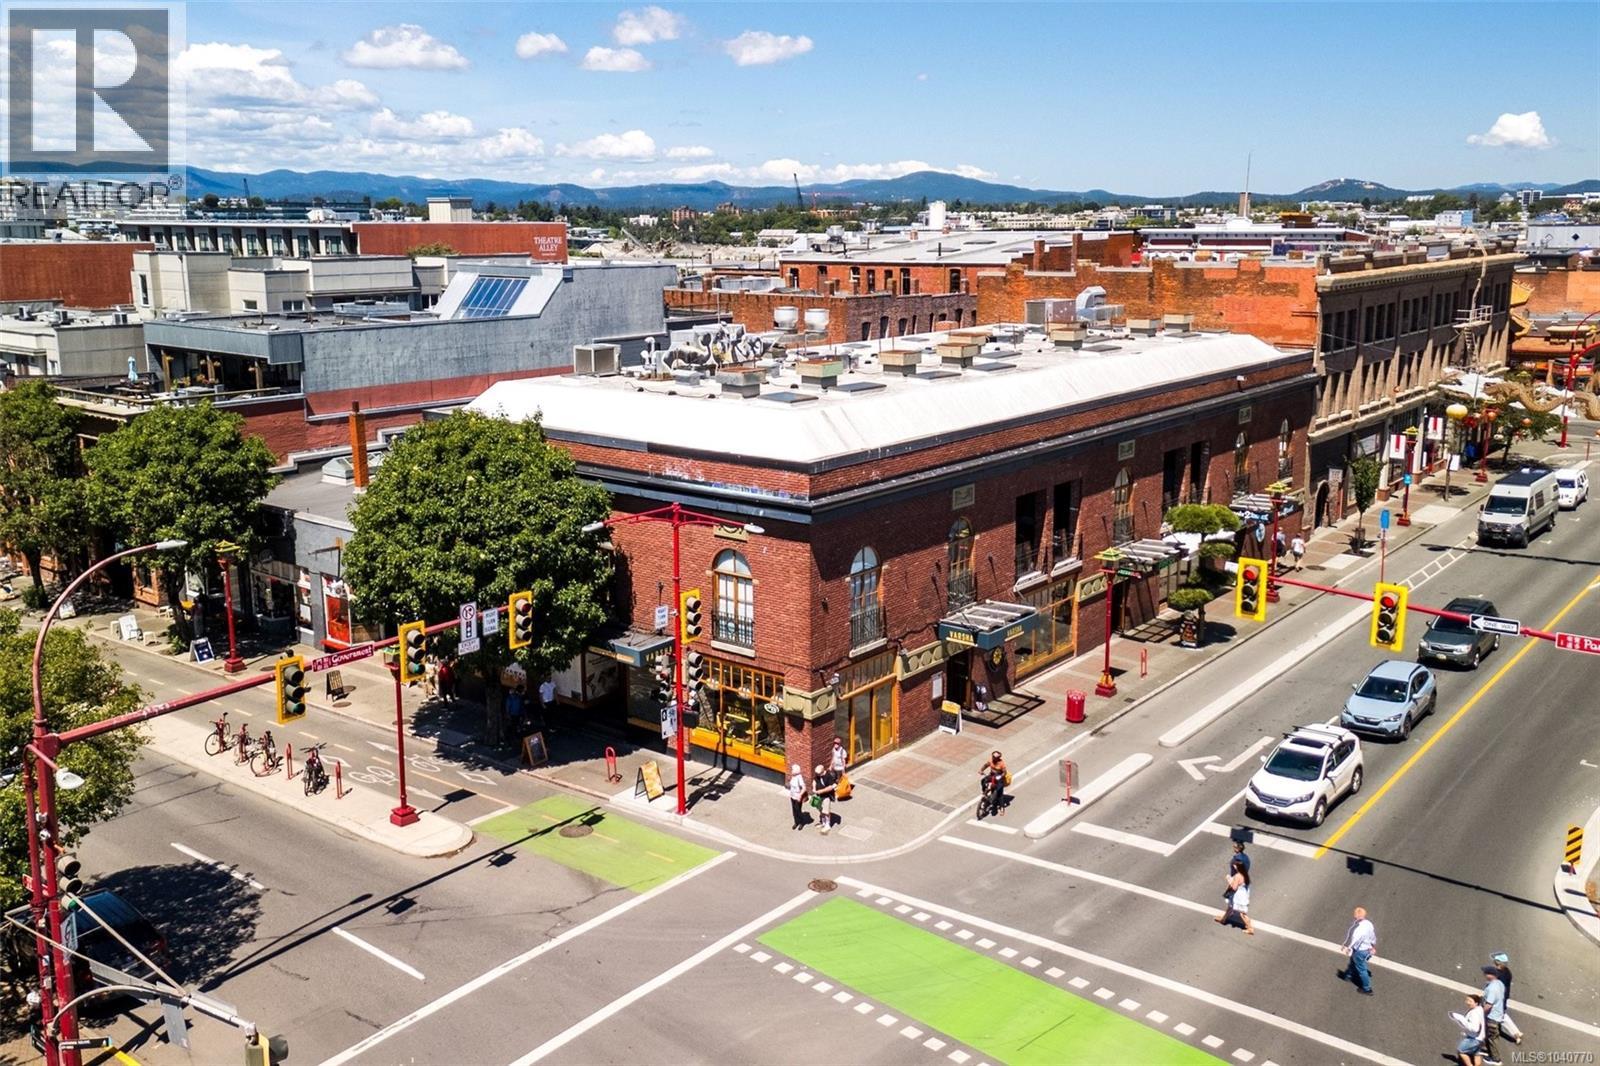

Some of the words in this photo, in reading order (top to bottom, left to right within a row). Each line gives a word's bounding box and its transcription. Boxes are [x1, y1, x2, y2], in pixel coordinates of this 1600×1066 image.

[533, 236, 562, 244] THEATRE
[539, 244, 558, 252] ALLEY
[1483, 620, 1497, 628] ONE
[1501, 623, 1515, 631] WAY
[949, 631, 973, 641] VARSHA
[331, 645, 372, 664] Government
